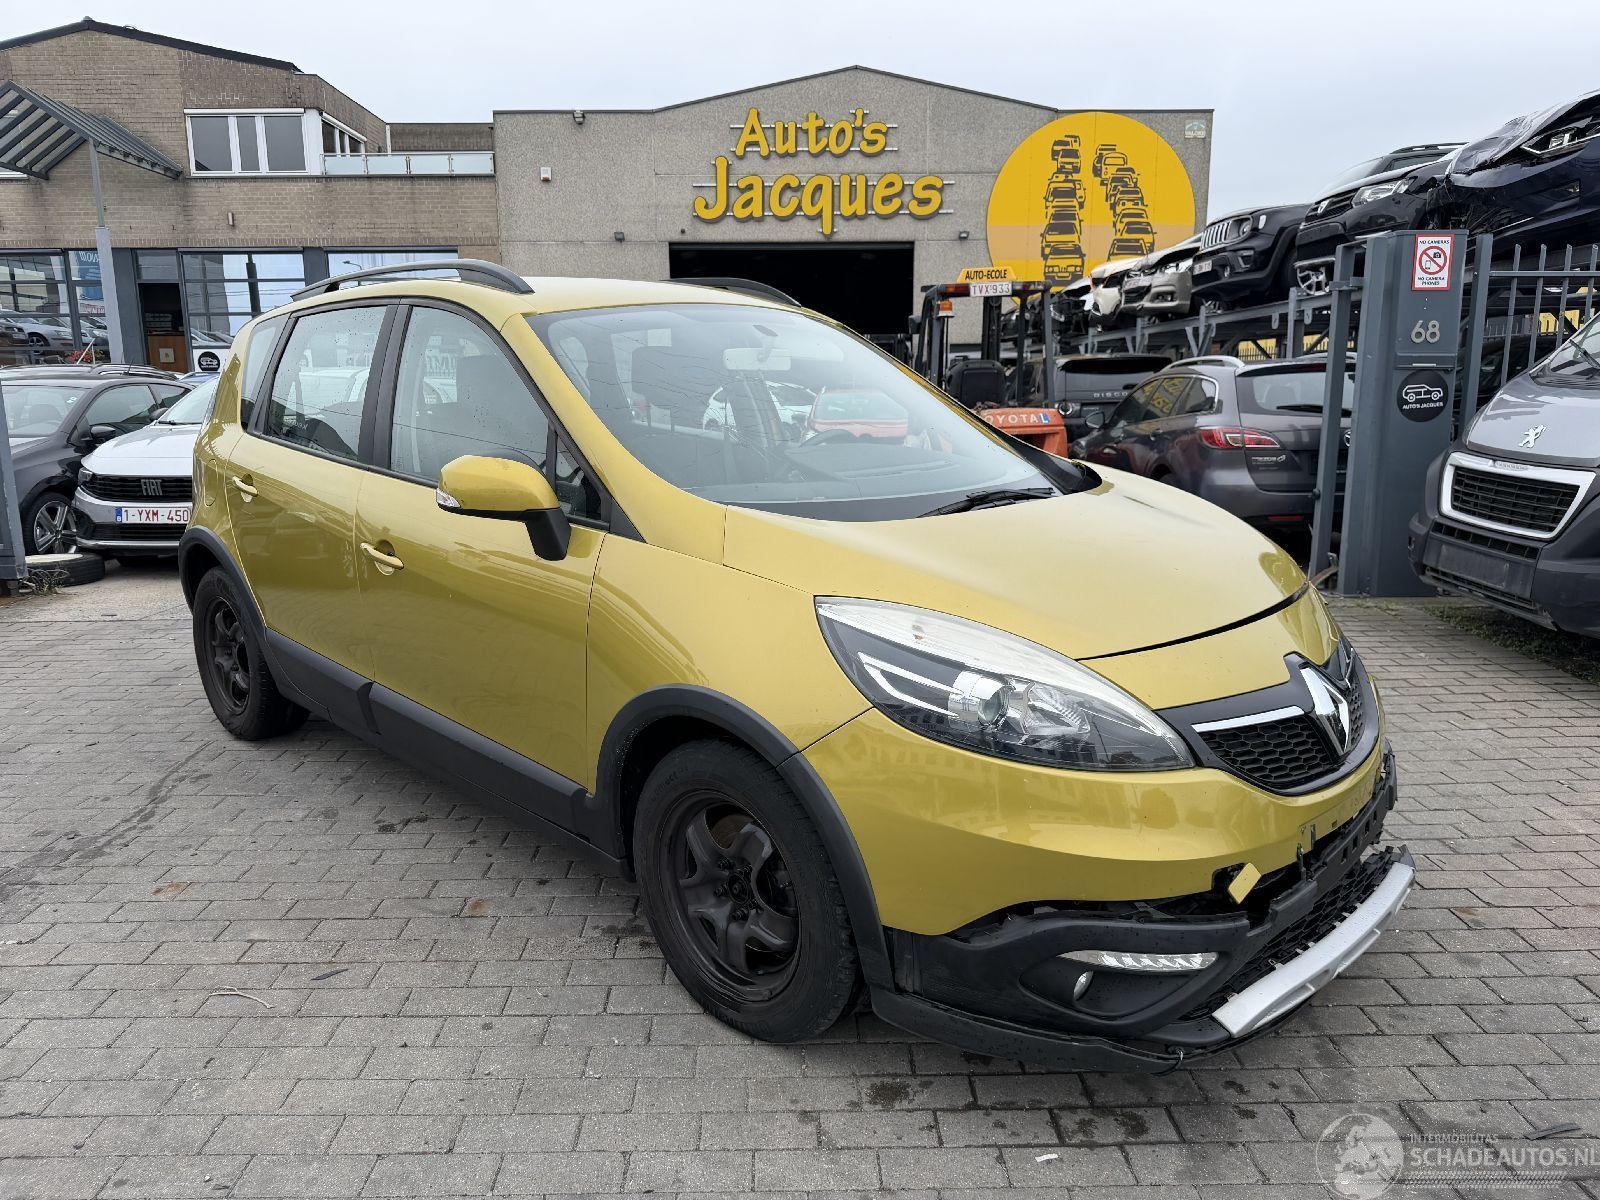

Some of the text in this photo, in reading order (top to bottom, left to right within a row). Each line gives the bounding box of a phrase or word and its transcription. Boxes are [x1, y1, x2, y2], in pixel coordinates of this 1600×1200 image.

[735, 107, 889, 158] Auto's
[693, 156, 945, 236] Jacques
[965, 269, 1007, 280] AUTO-ECOLE
[1410, 320, 1440, 343] 68
[984, 413, 1038, 424] OYOTA
[140, 479, 163, 496] FIAT
[123, 509, 189, 522] 1-YXM-450
